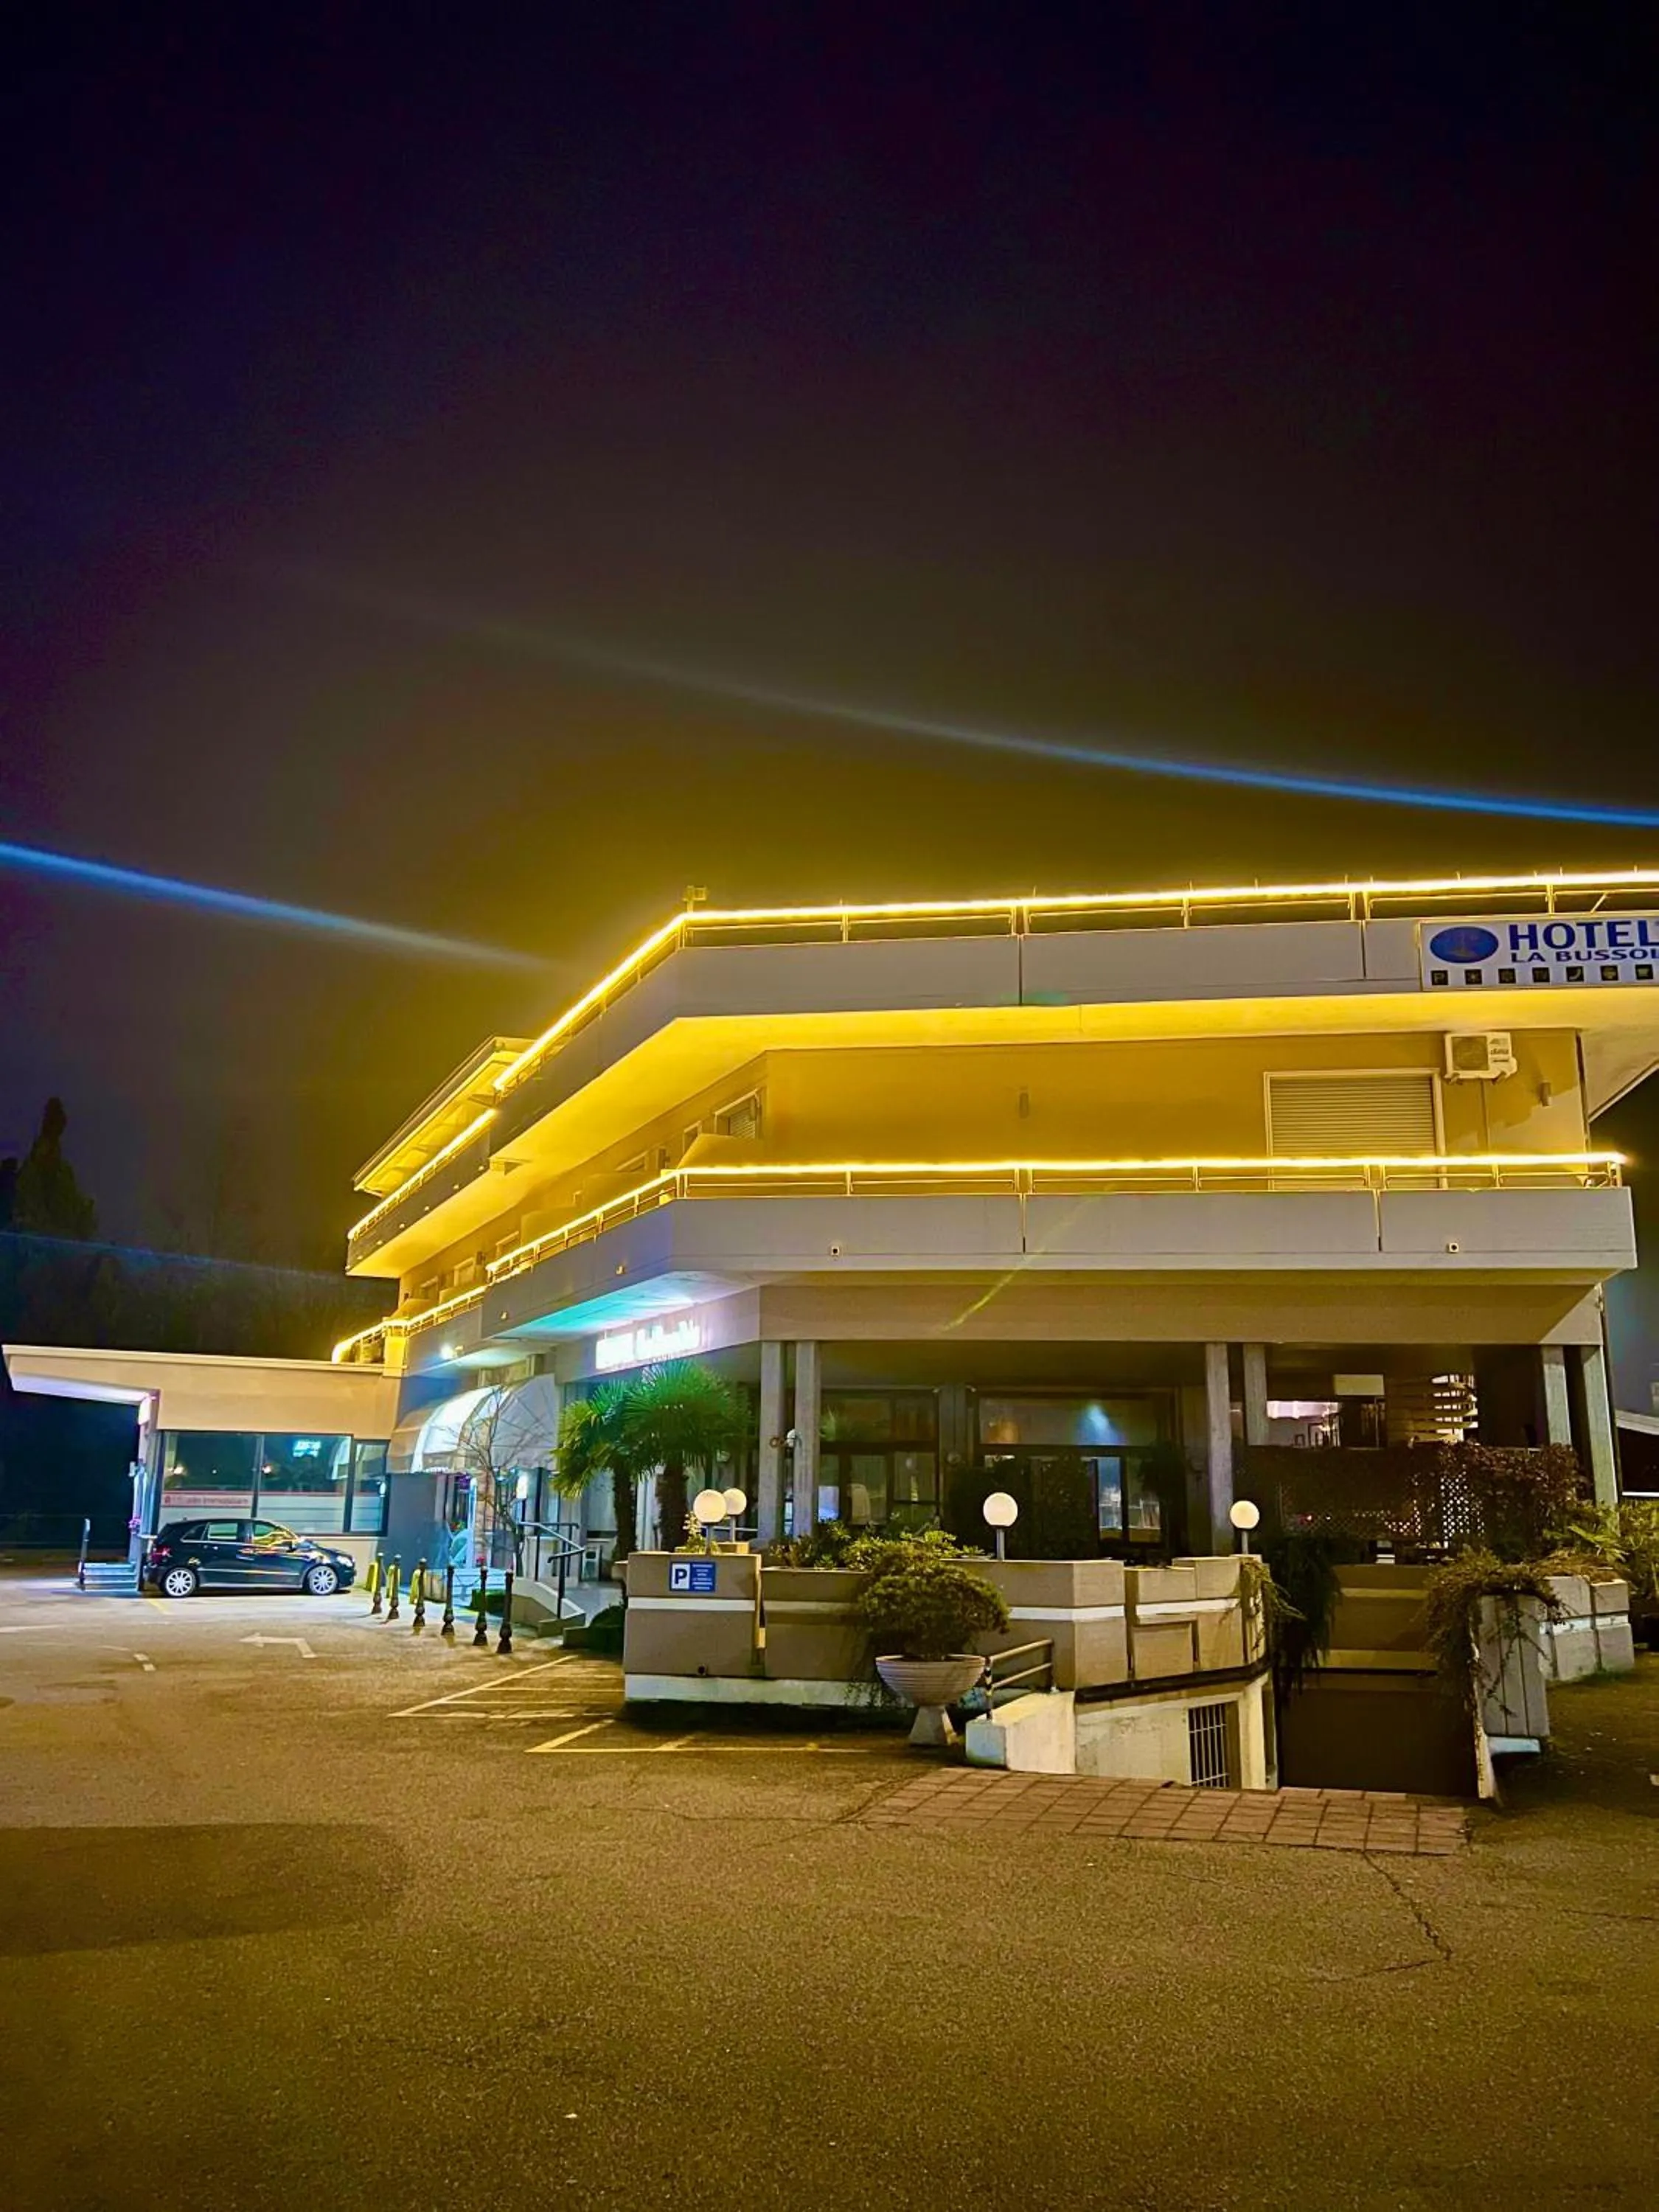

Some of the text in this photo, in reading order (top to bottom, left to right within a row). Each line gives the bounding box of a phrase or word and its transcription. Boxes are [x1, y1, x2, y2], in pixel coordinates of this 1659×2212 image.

[1509, 920, 1659, 950] HOTEL
[1511, 952, 1546, 962] LA
[675, 1568, 687, 1585] P
